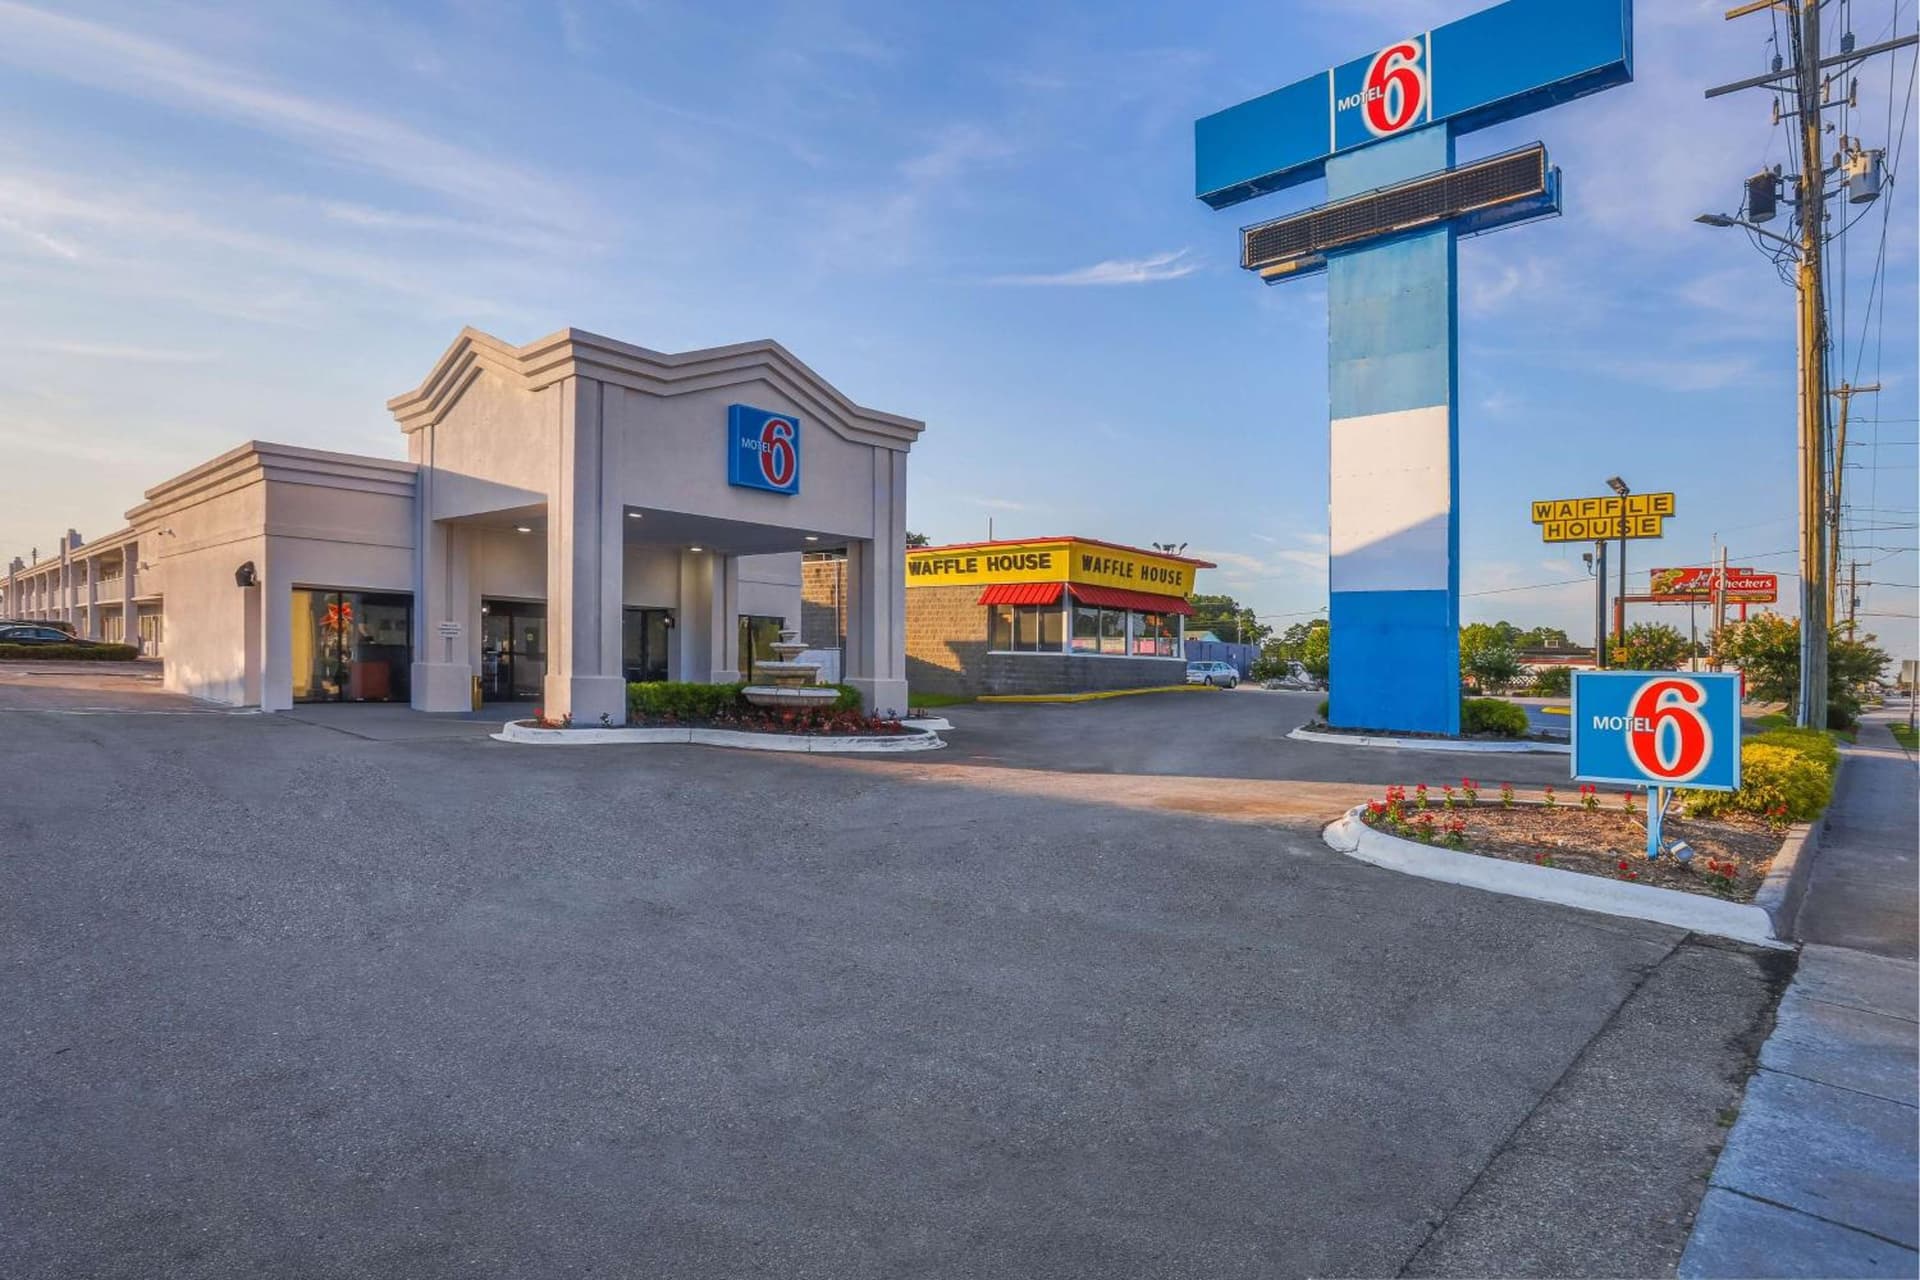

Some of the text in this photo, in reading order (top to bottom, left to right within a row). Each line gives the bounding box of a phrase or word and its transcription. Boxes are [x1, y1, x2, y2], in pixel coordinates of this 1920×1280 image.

[1338, 39, 1425, 137] MOTEL 6
[741, 417, 796, 488] MOTEL 6
[1536, 496, 1668, 518] WAFFLE
[1548, 518, 1656, 537] HOUSE
[908, 553, 1051, 576] WAFFLE HOUSE
[1082, 554, 1183, 586] WAFFLE HOUSE
[1593, 677, 1713, 782] MOTEL 6
